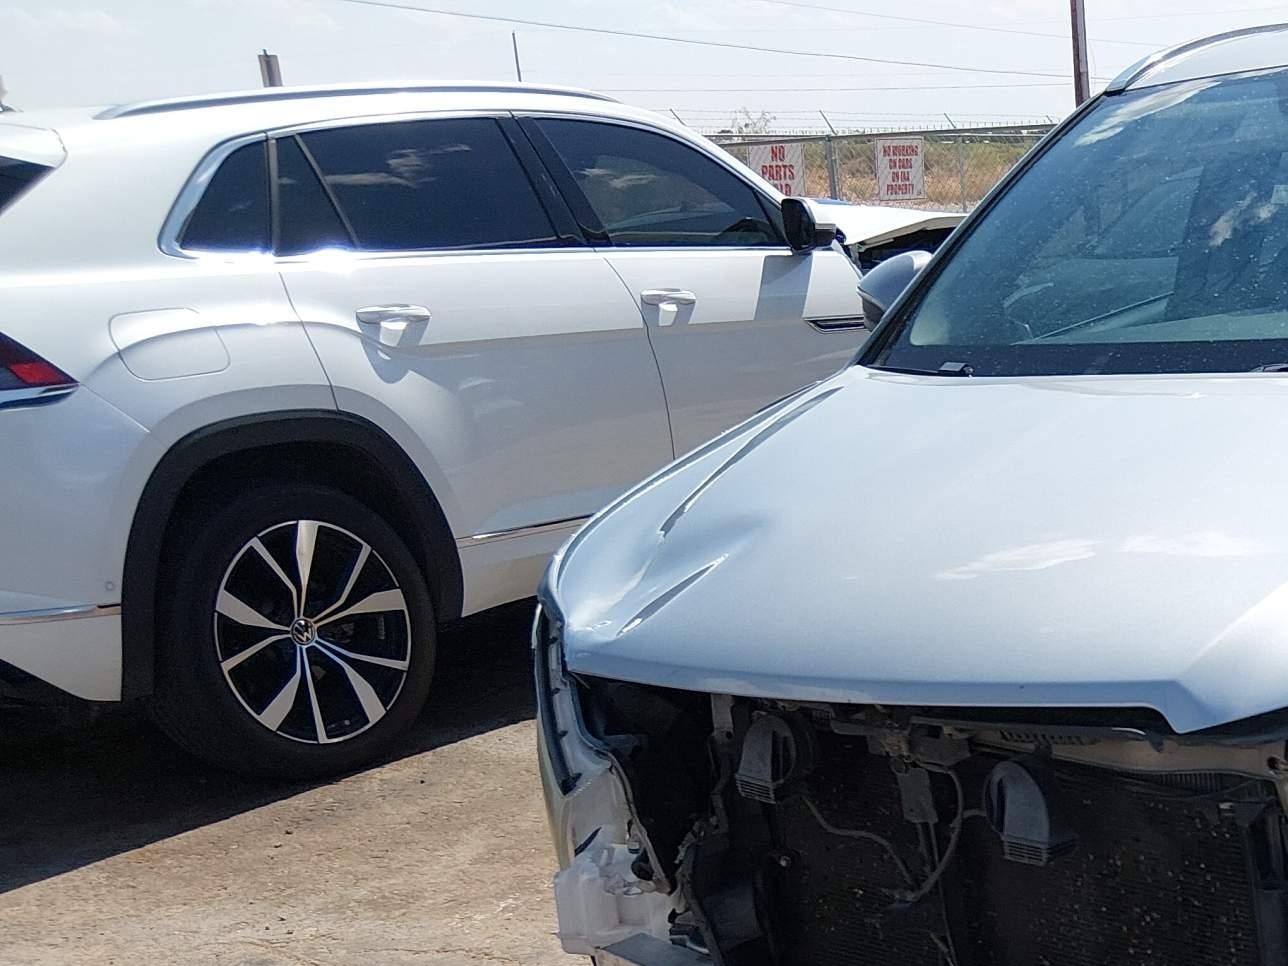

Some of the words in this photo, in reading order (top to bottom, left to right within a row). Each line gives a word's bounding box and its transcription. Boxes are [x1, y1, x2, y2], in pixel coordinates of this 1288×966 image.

[771, 145, 785, 161] NO
[882, 145, 892, 157] NO
[889, 158, 897, 170] ON
[898, 158, 913, 170] CARS
[761, 164, 795, 181] PARTS
[892, 171, 900, 182] ON
[886, 183, 915, 196] PROPERTY
